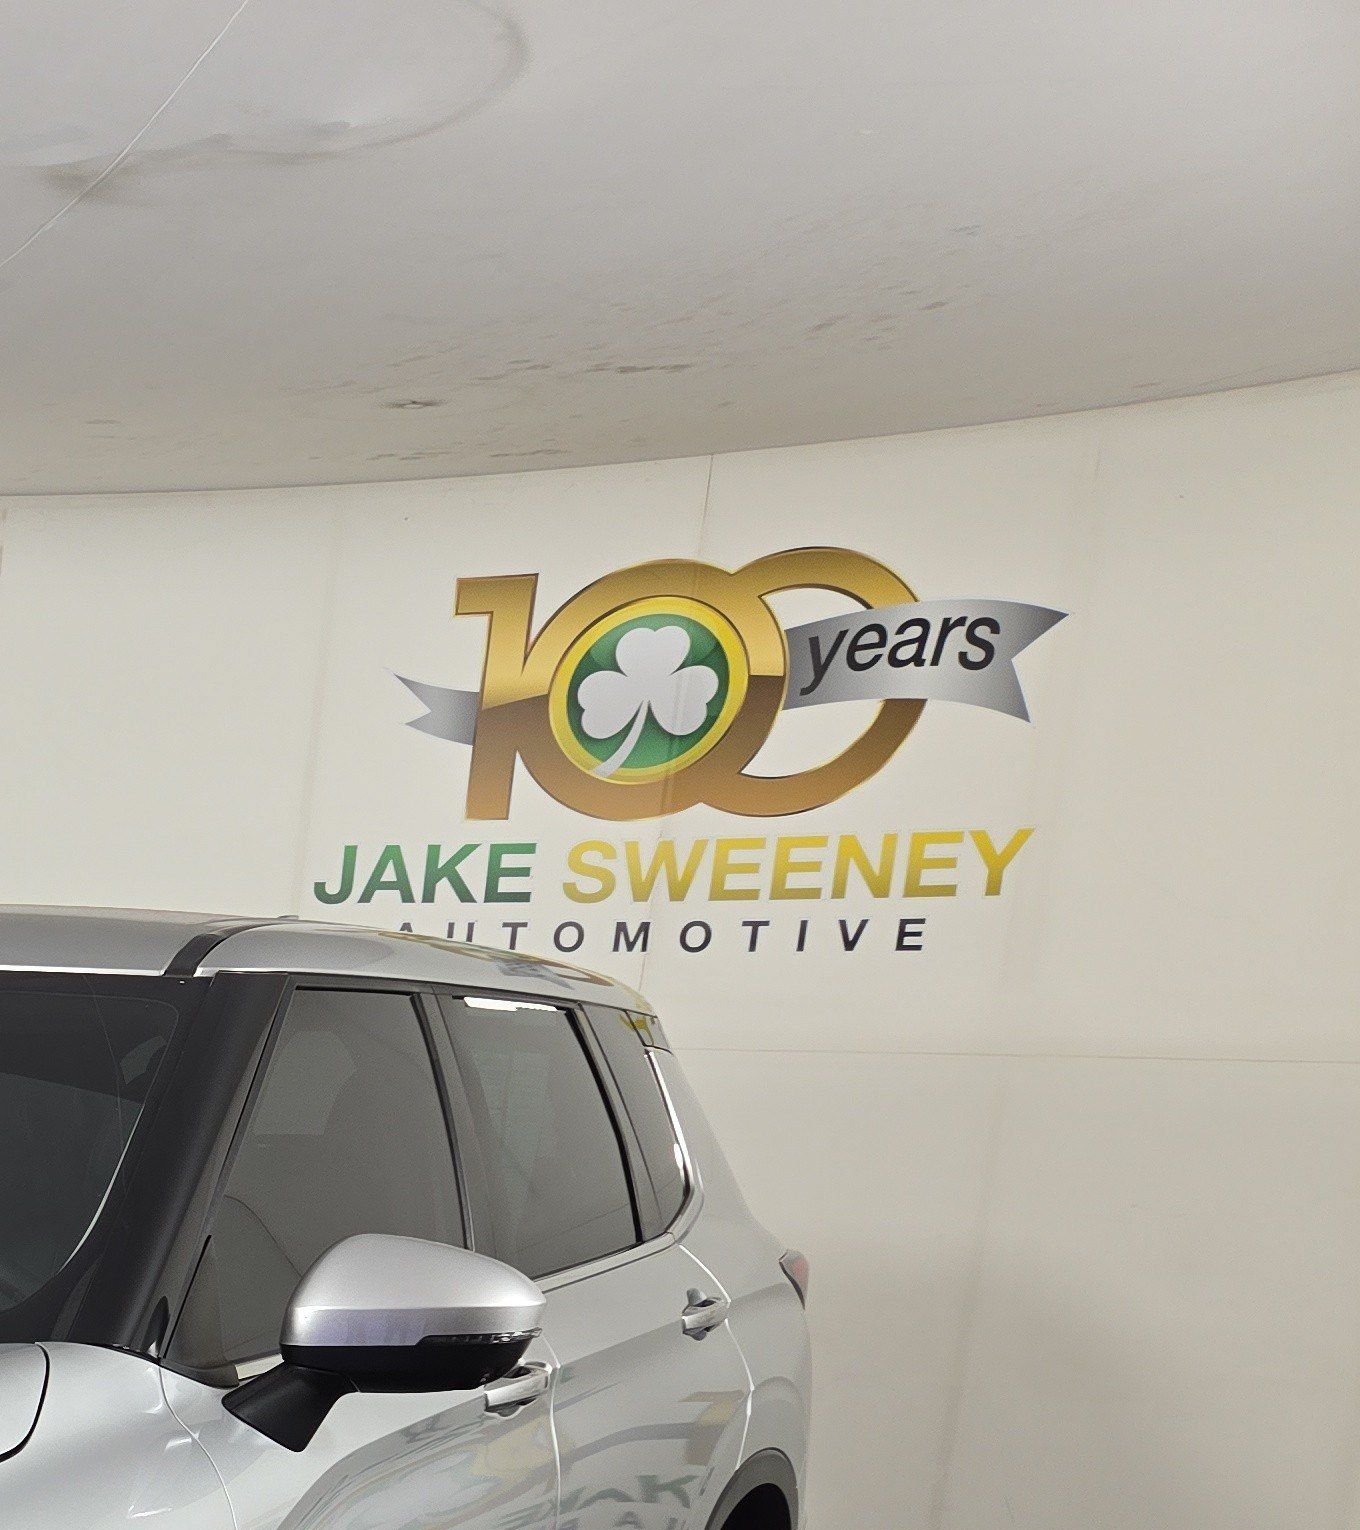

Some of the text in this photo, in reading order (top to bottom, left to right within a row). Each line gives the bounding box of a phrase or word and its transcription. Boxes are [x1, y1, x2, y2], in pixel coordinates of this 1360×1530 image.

[454, 546, 1001, 821] 100 years
[313, 827, 1037, 905] JAKE SWEENEY
